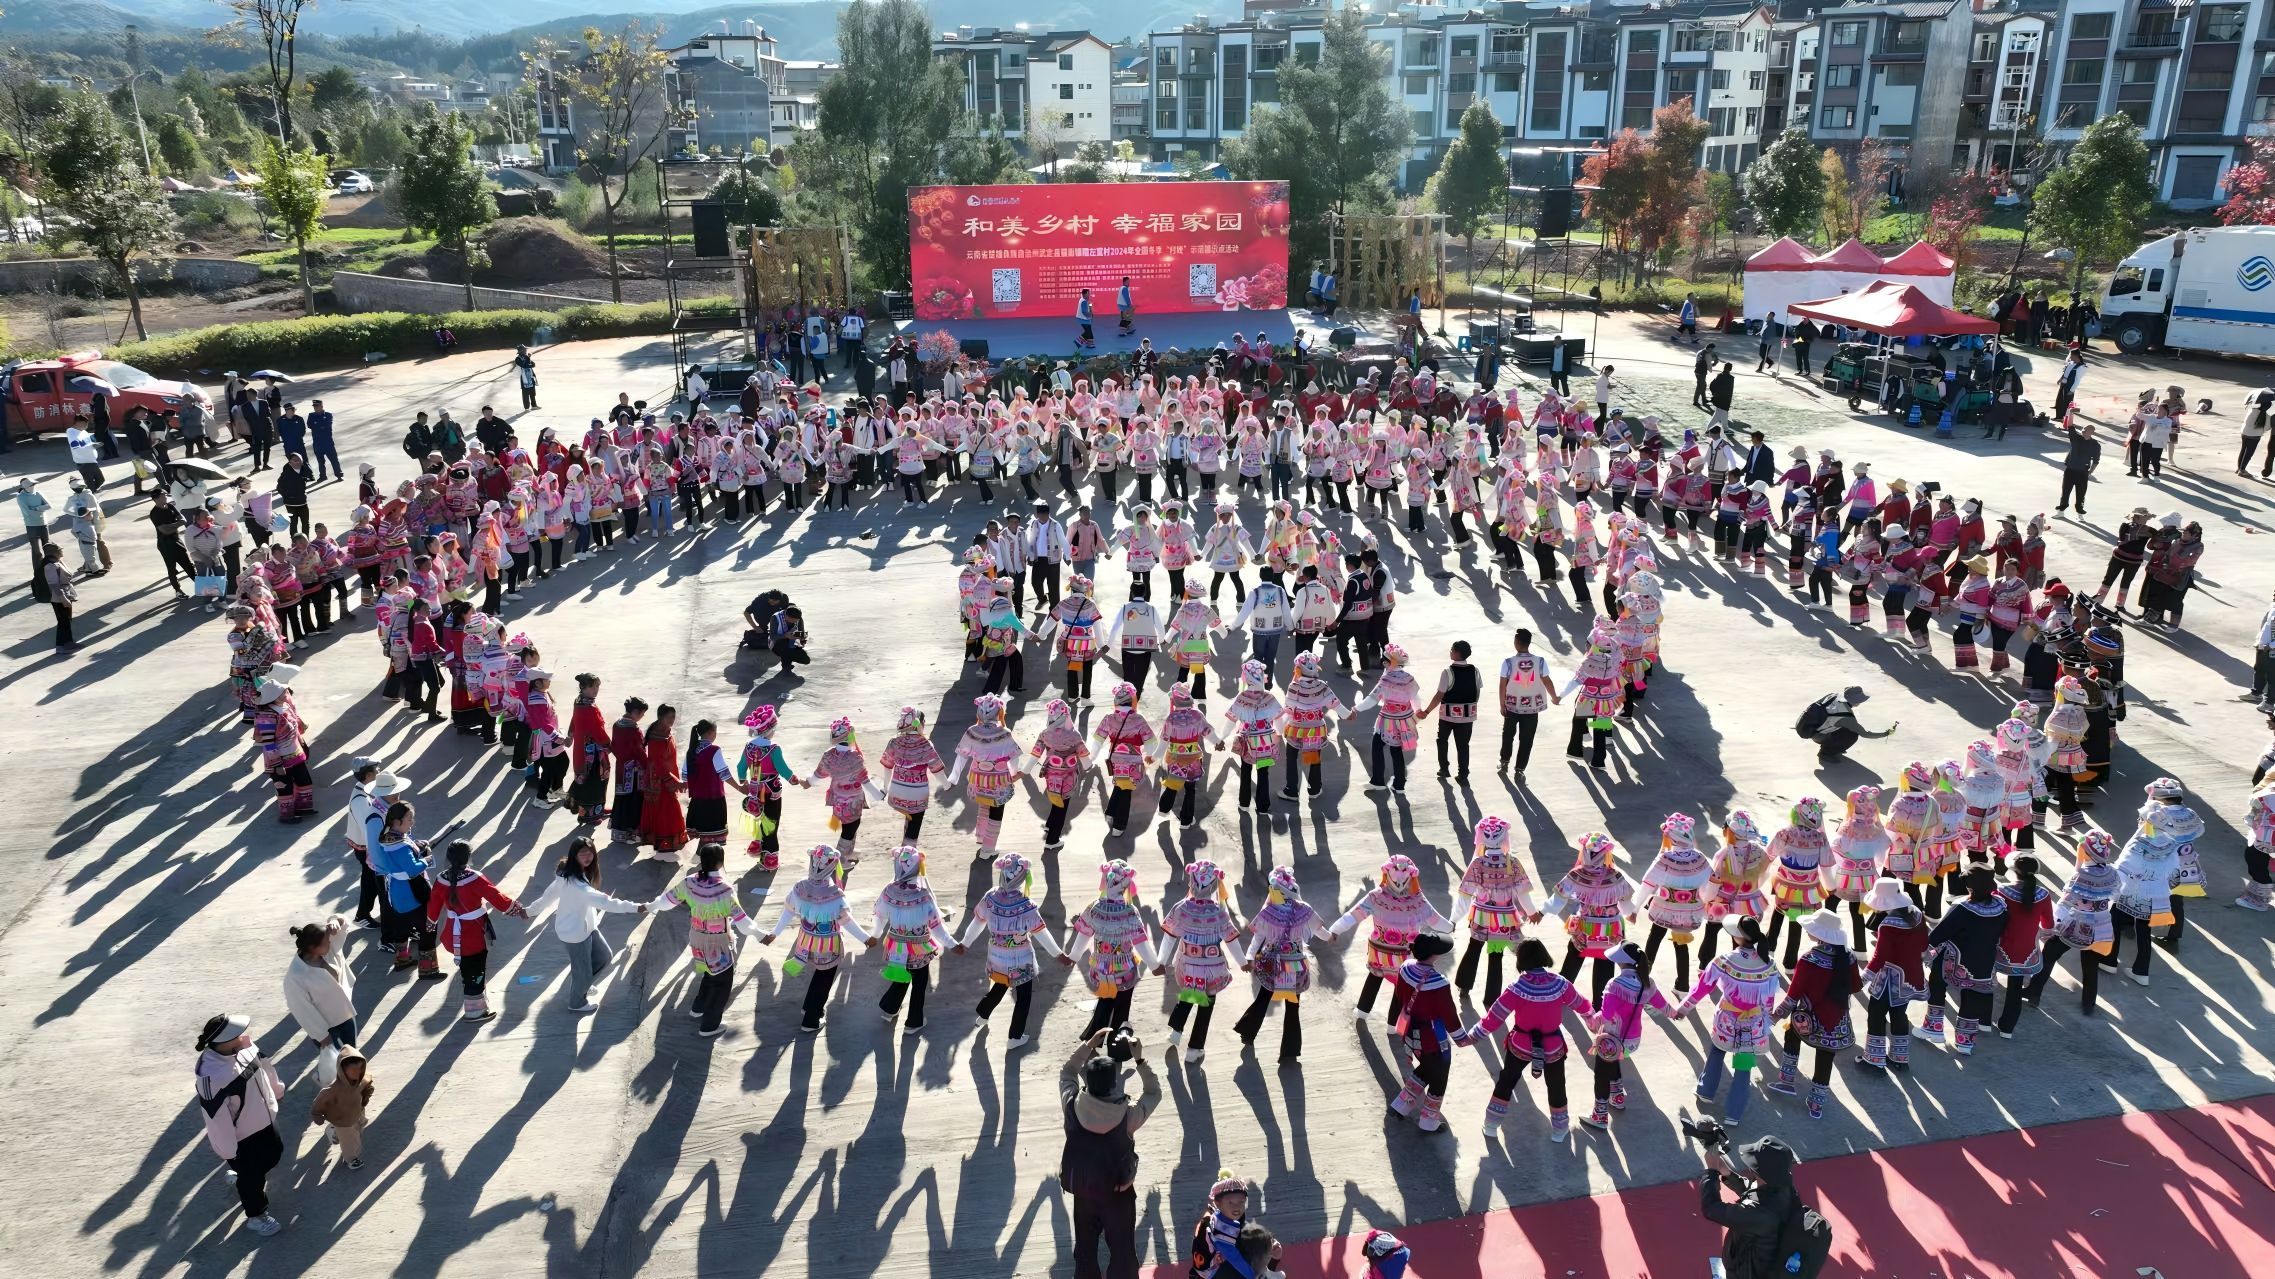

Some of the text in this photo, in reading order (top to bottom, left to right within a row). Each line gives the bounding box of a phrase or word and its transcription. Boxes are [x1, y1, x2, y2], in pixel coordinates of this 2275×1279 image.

[962, 212, 1242, 238] 和美乡村 幸福家园
